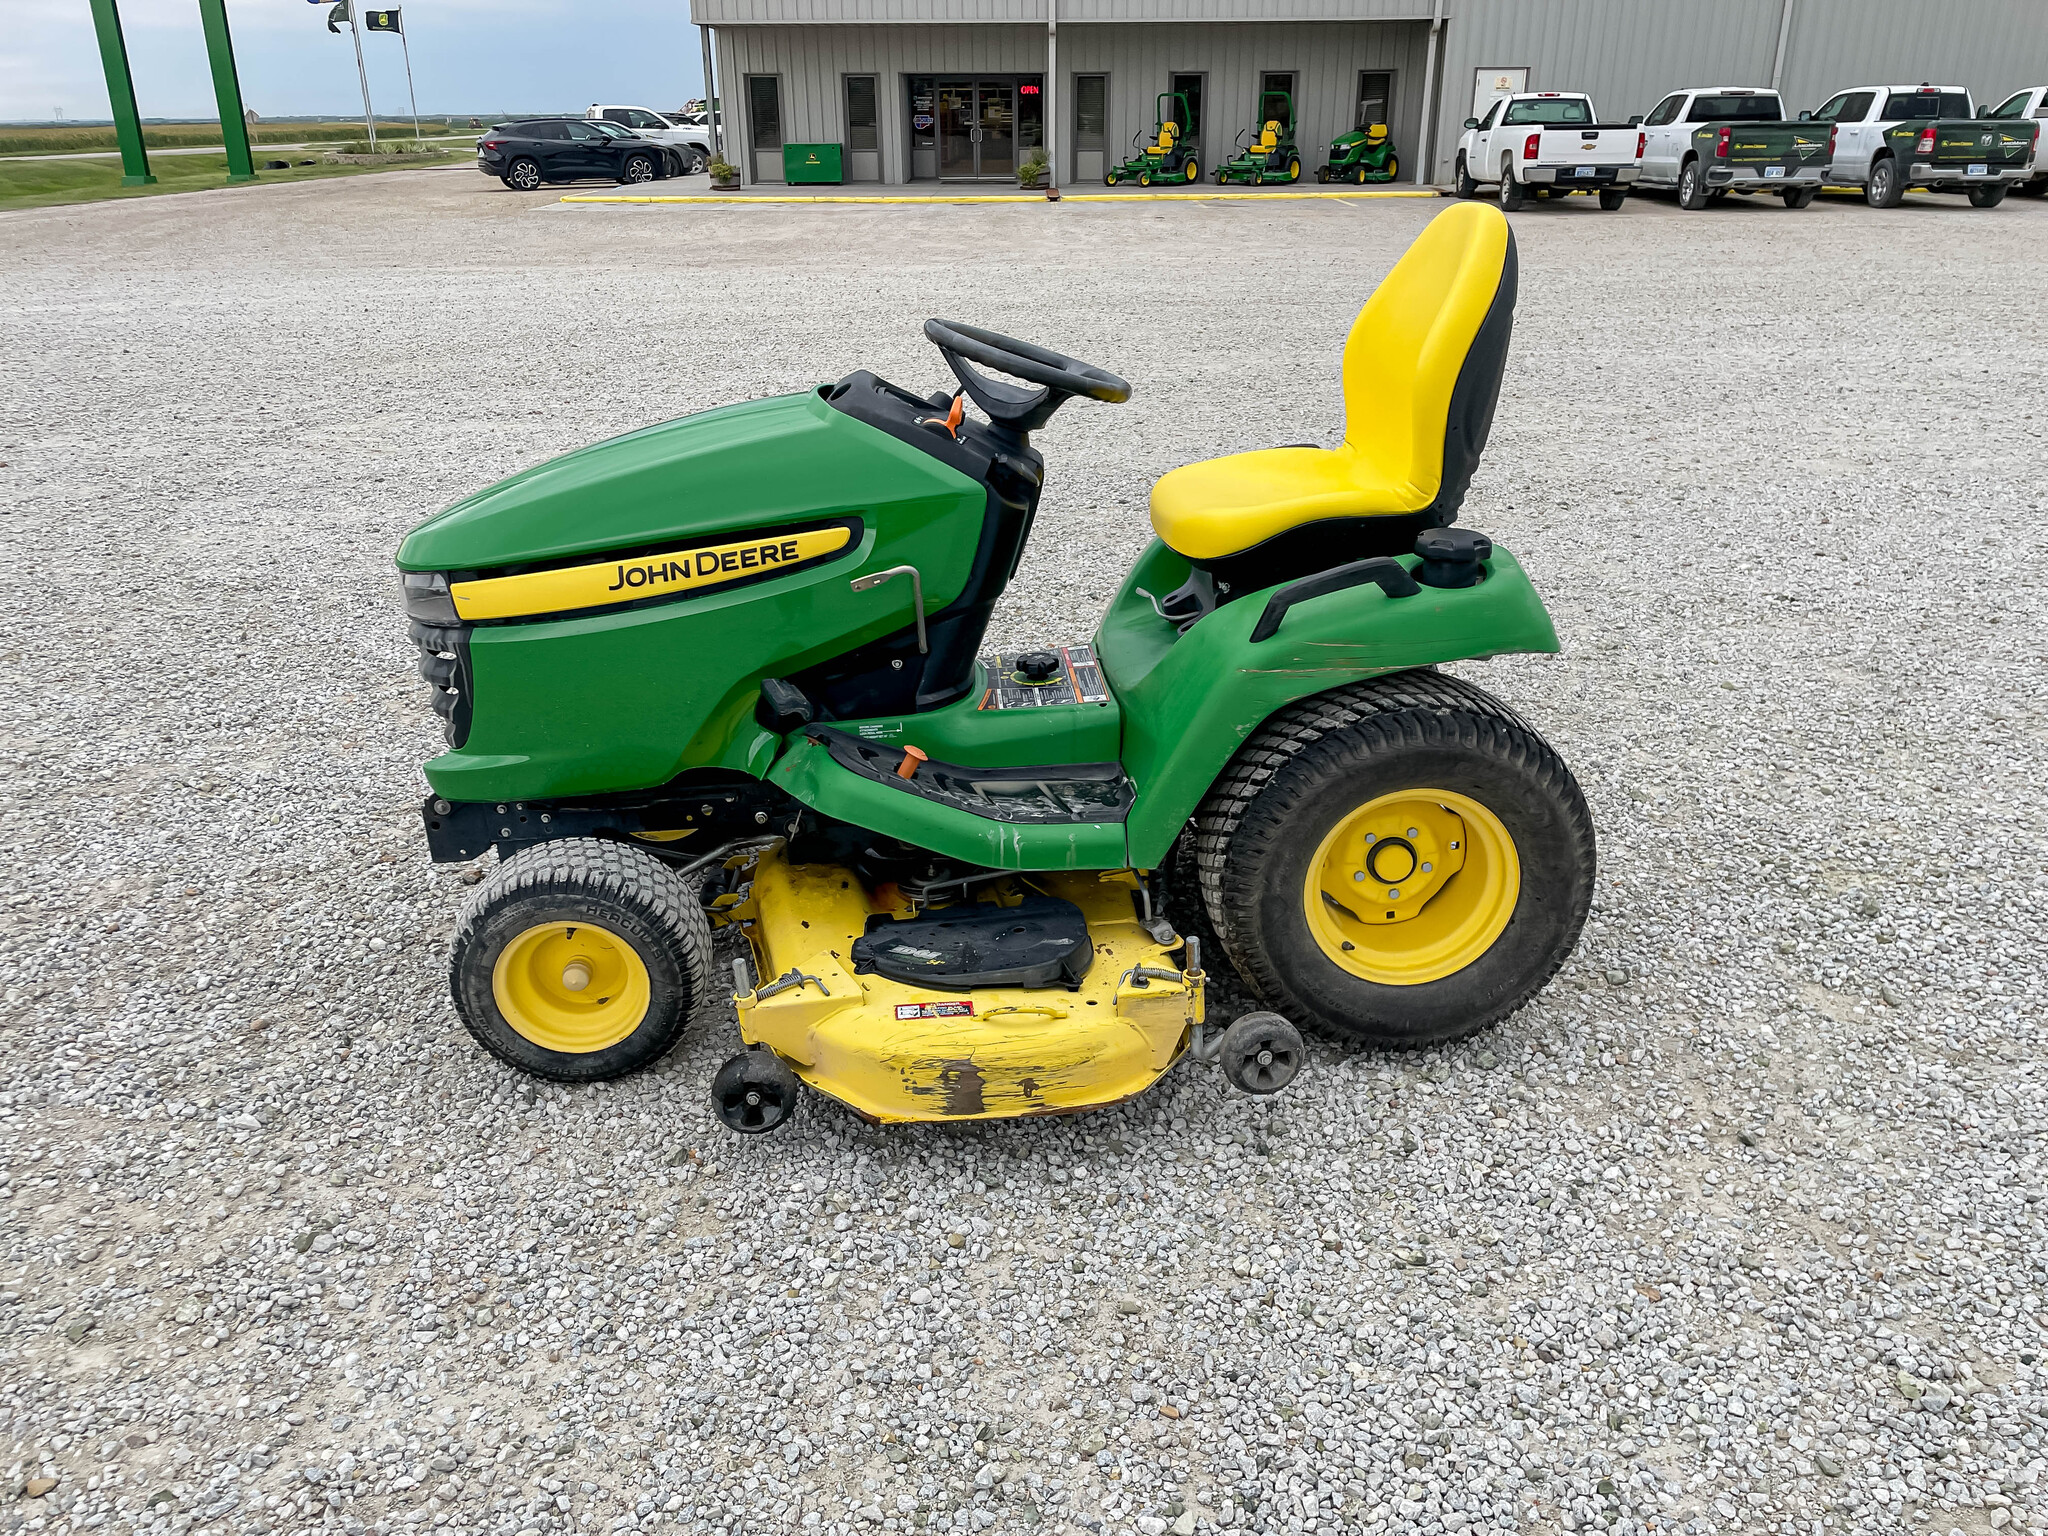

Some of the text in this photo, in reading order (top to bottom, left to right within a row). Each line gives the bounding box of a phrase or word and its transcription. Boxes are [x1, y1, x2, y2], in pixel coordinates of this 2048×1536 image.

[1020, 85, 1039, 95] OPEN
[608, 540, 799, 591] JOHN DEERE
[586, 904, 663, 960] HERCULES
